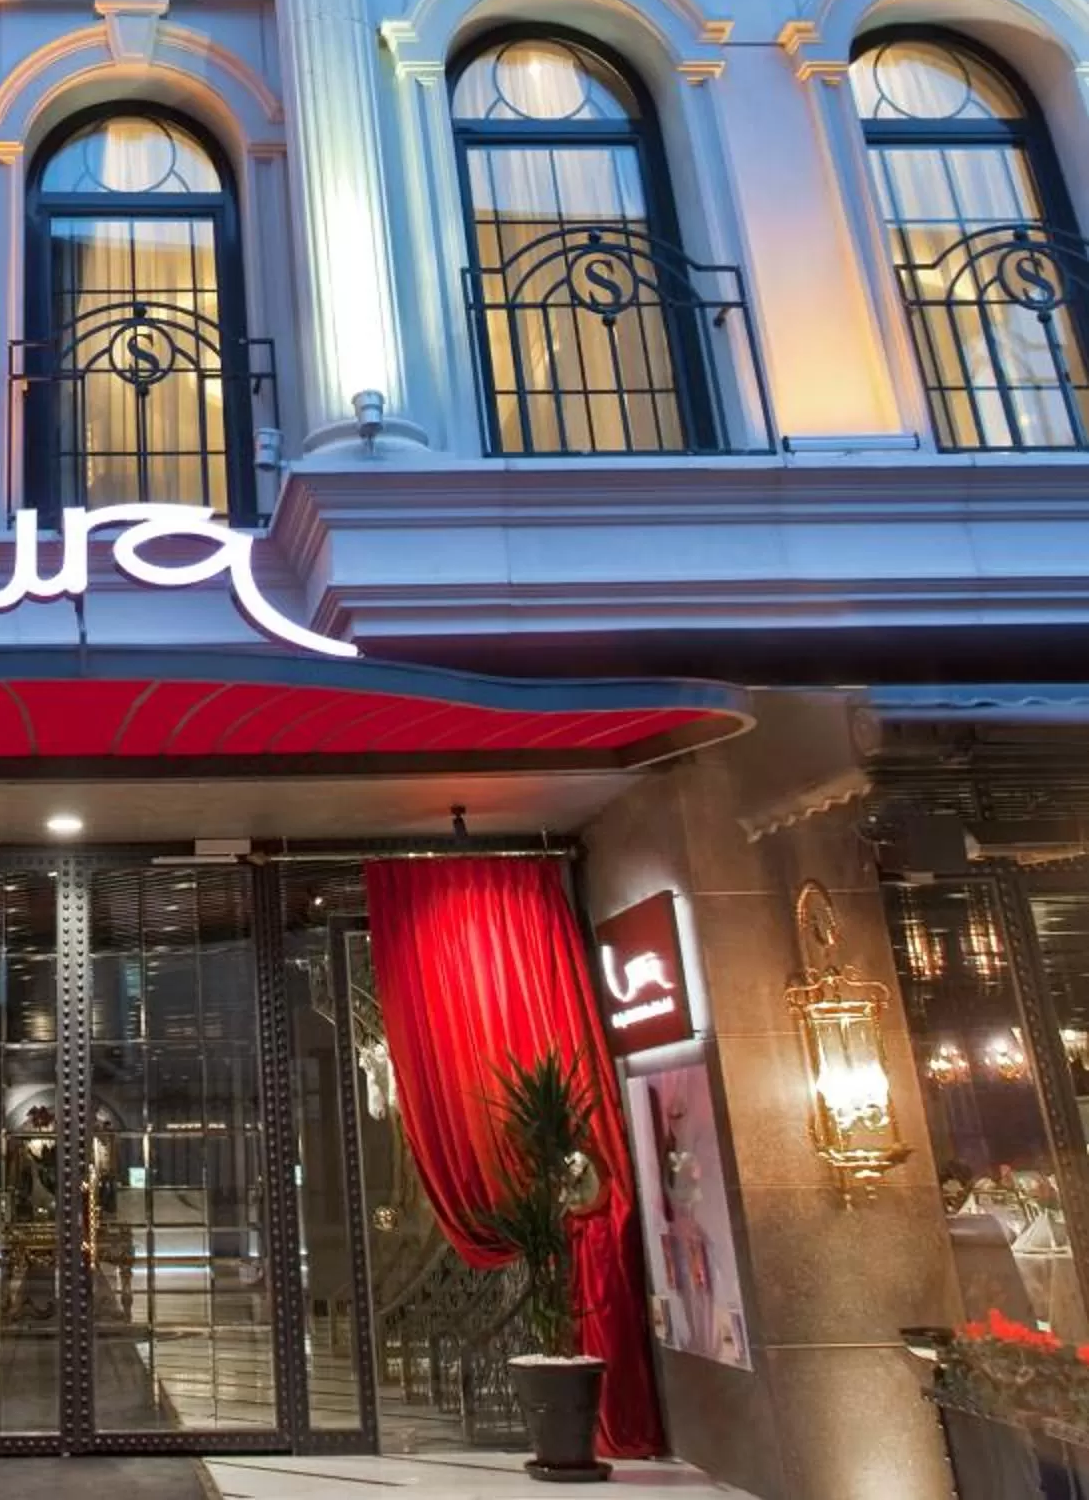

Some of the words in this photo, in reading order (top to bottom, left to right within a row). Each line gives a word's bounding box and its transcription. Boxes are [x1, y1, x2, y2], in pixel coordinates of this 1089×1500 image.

[585, 259, 621, 311] S
[1017, 257, 1053, 308] S
[127, 333, 160, 379] S
